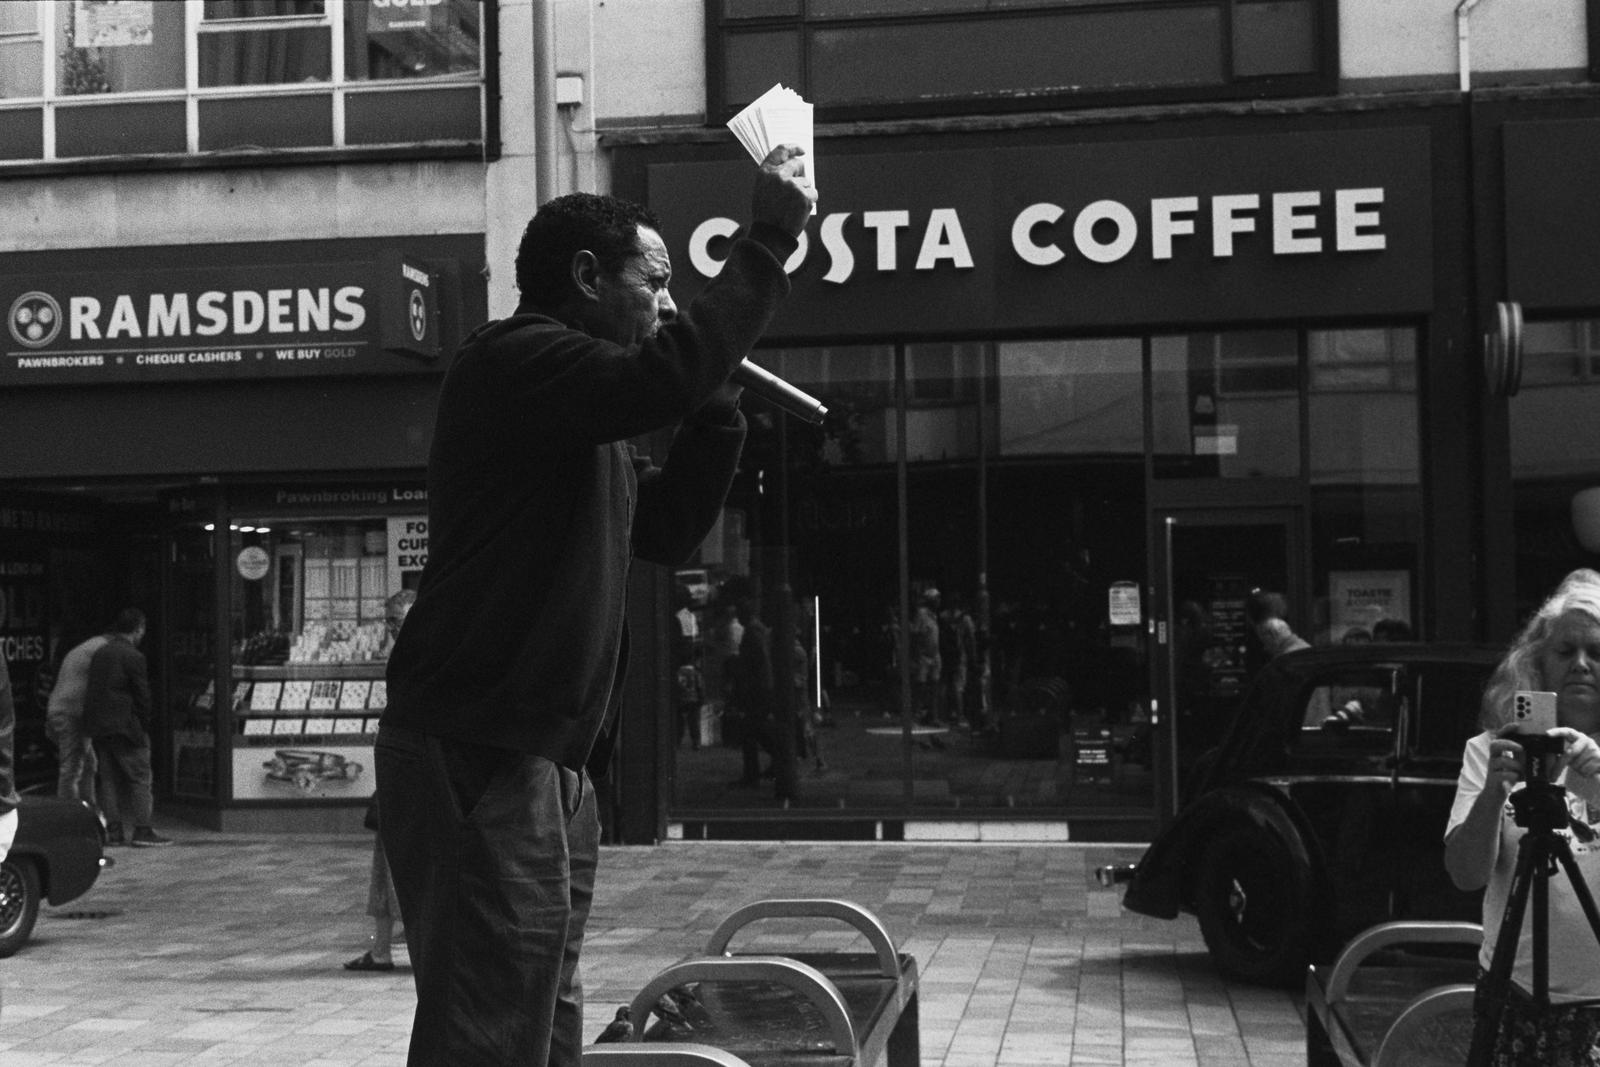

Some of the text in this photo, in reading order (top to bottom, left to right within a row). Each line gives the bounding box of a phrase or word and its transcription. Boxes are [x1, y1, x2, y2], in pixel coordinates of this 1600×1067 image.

[1011, 186, 1387, 266] COFFEE
[69, 286, 366, 340] RAMSDENS
[17, 355, 105, 368] PAWNBROKERS
[136, 351, 242, 366] CHEQUE CASHERS
[275, 347, 357, 361] WE BUY GOLD
[275, 489, 388, 504] Pawnbroking
